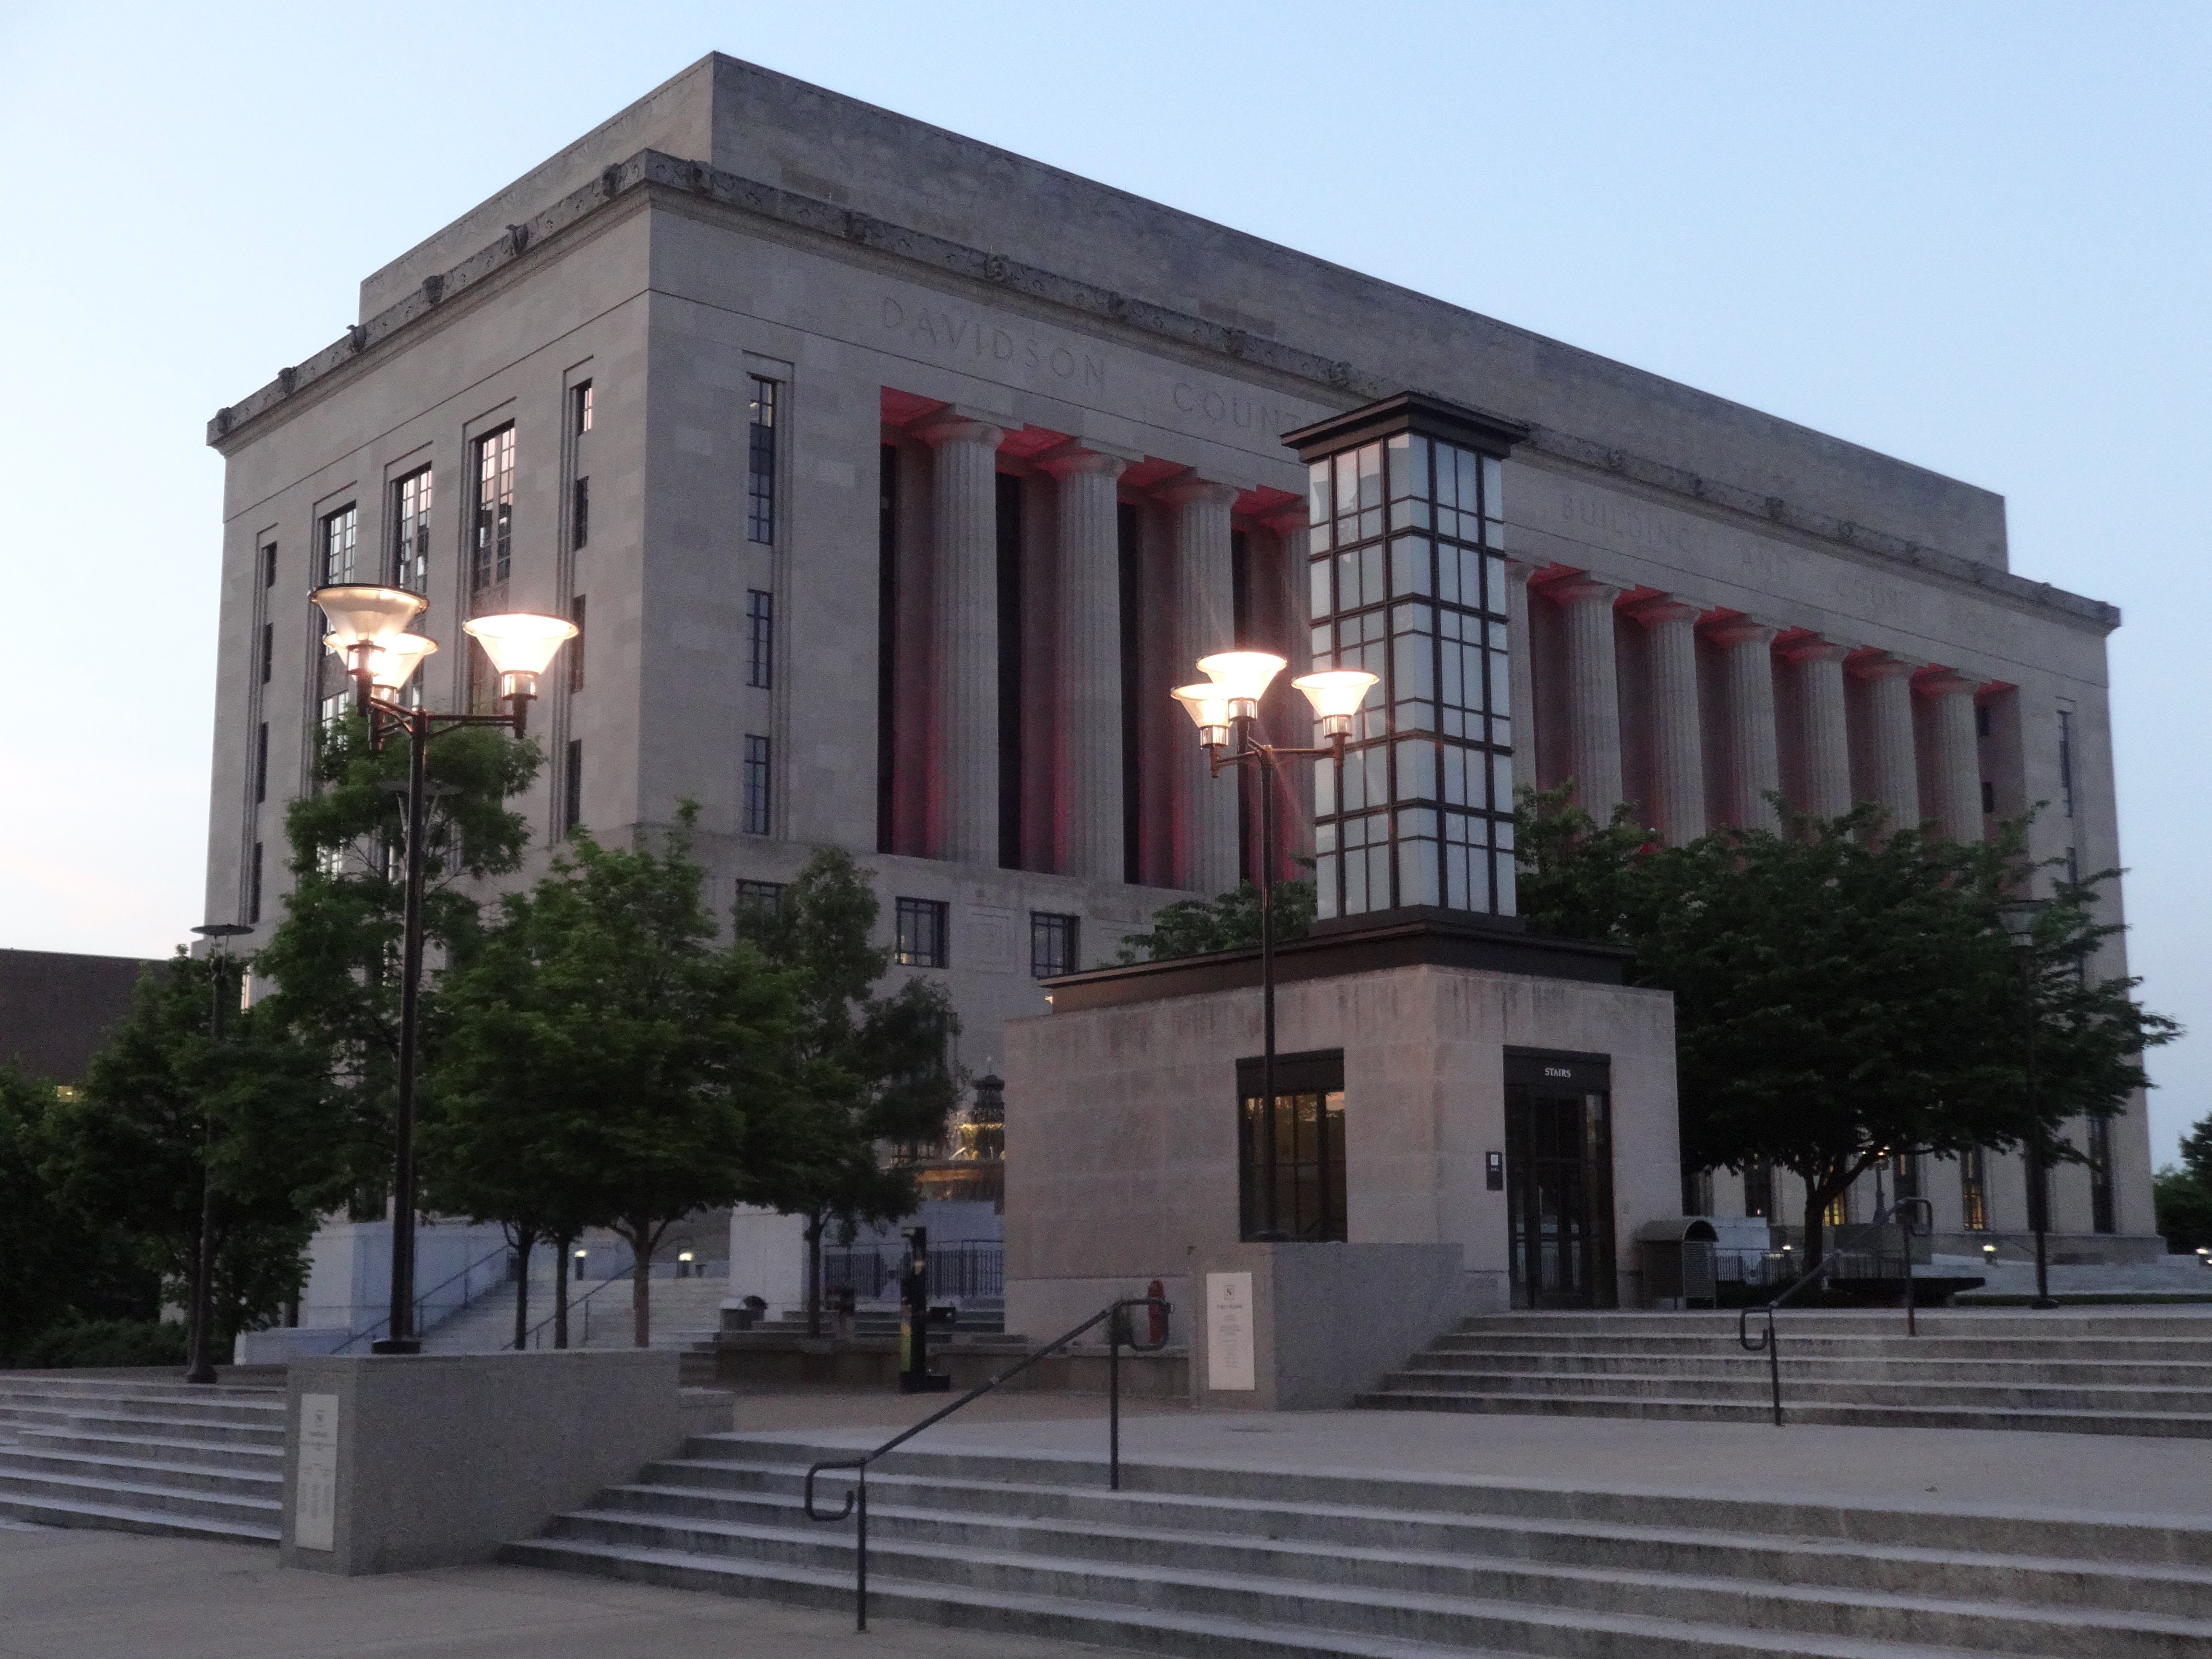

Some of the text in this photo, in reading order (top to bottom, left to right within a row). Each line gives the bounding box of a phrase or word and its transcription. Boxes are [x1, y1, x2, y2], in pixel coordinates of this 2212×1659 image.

[882, 296, 1106, 387] DAVIDSON
[1172, 382, 1307, 436] COUNT
[1545, 1068, 1571, 1078] STAIRS
